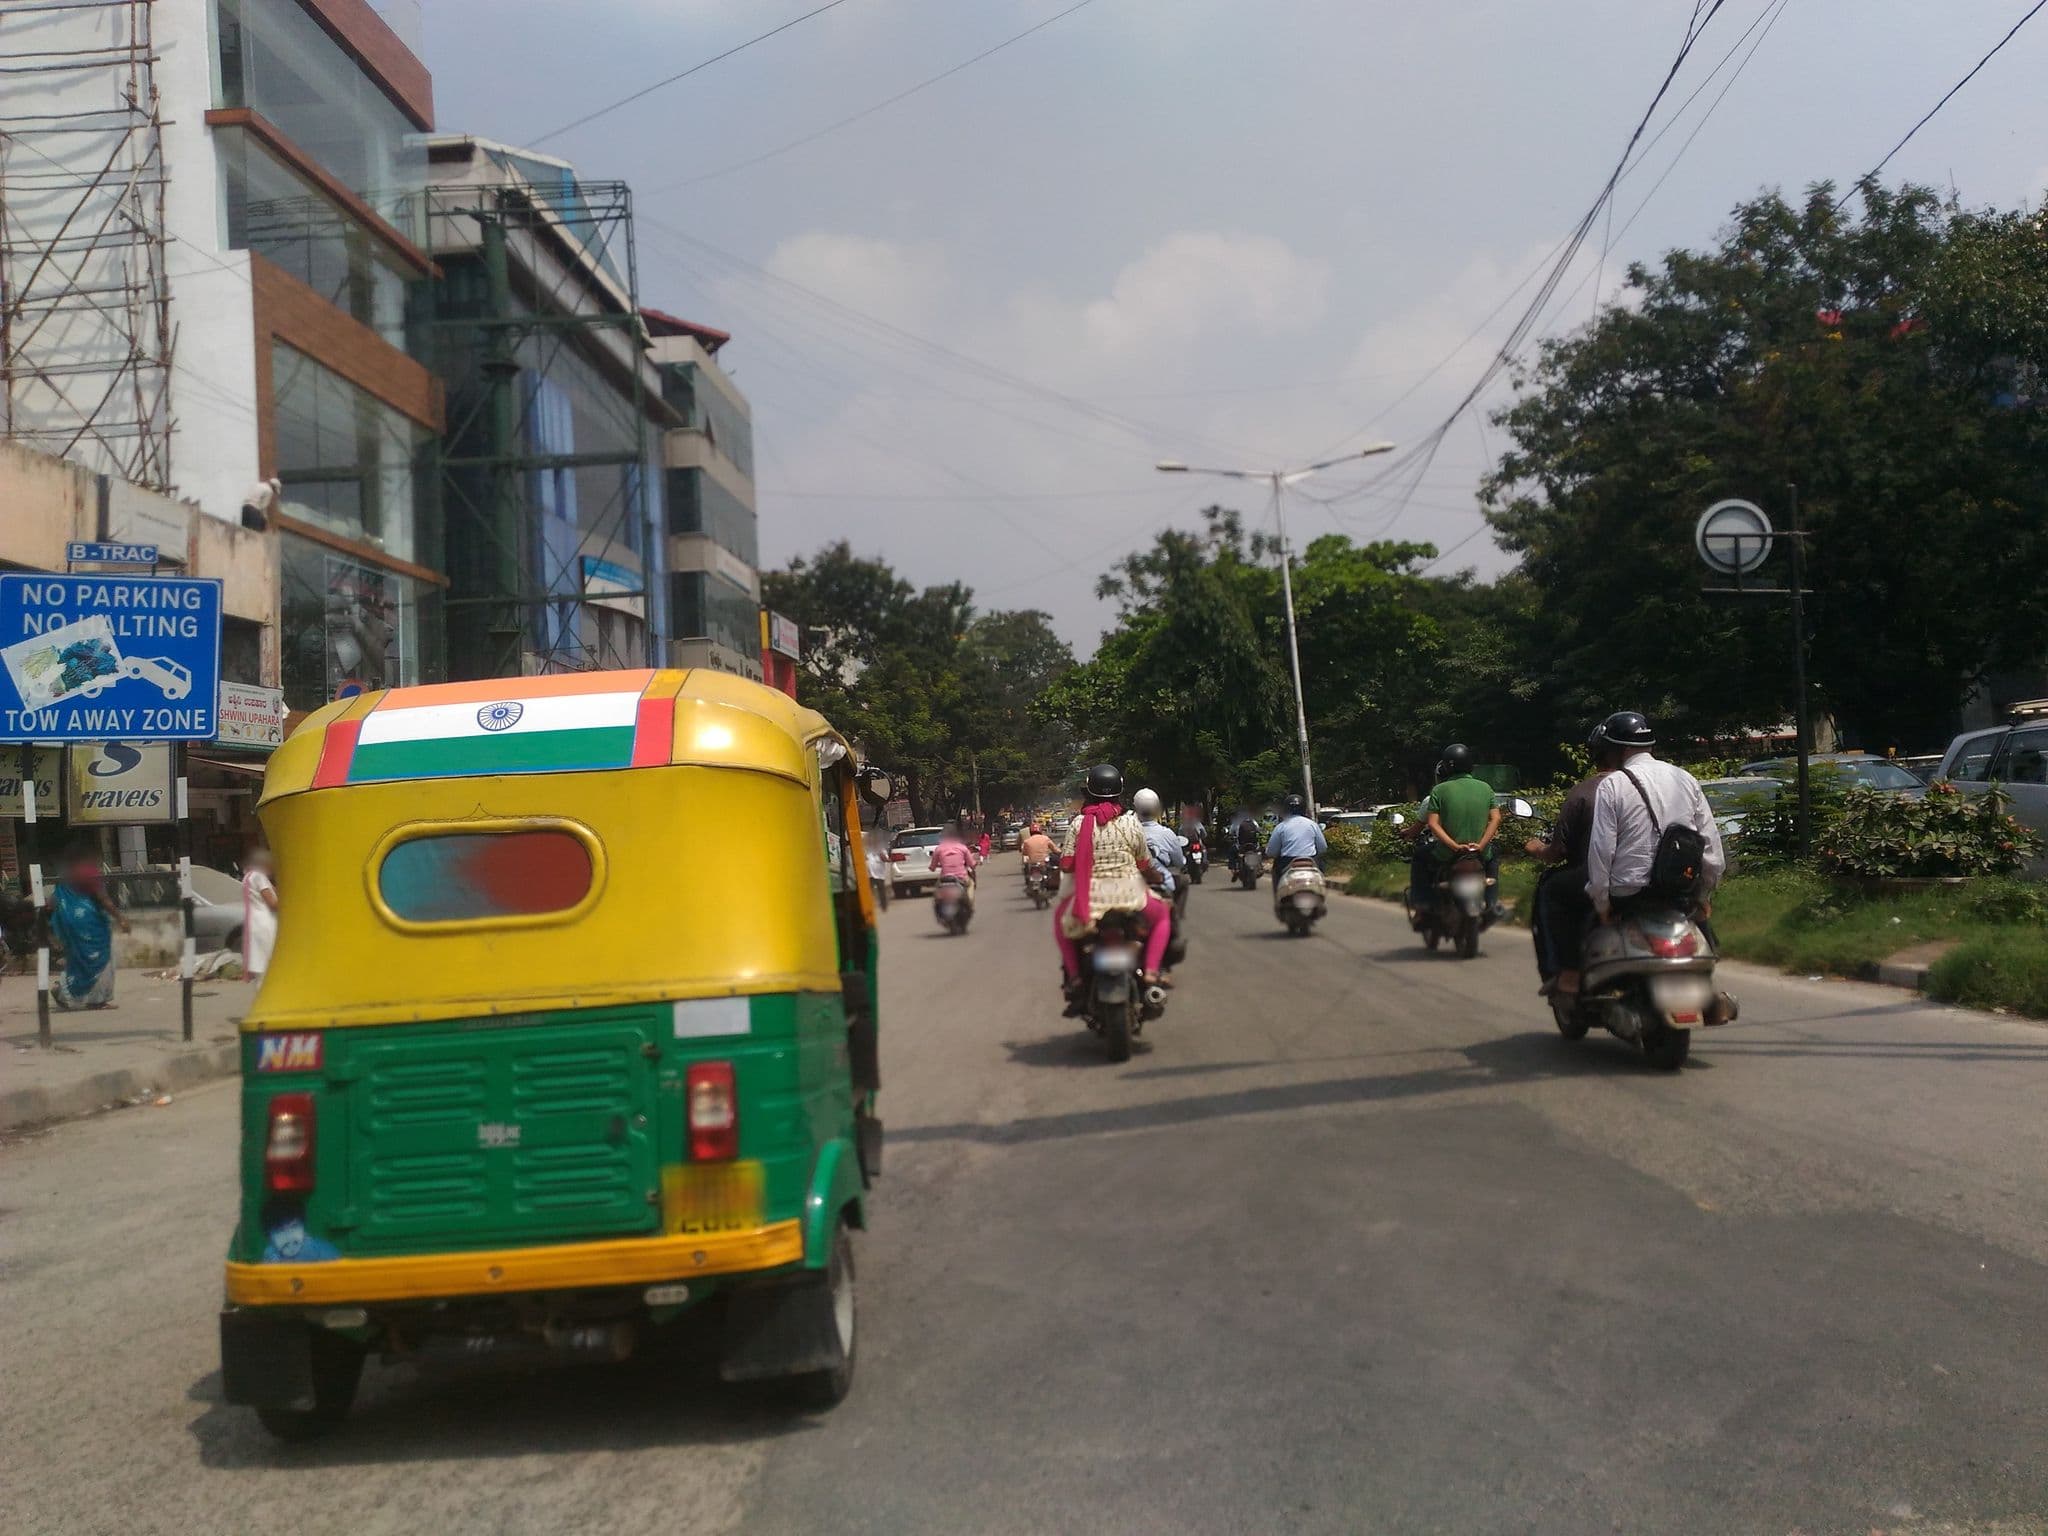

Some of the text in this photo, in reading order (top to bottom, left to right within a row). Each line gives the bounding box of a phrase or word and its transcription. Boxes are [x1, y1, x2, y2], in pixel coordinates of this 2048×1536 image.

[22, 583, 201, 609] NO PARKING
[23, 613, 198, 637] NO ALTING
[5, 709, 206, 732] TOW AWAY ZONE
[249, 712, 280, 726] UPAHARA
